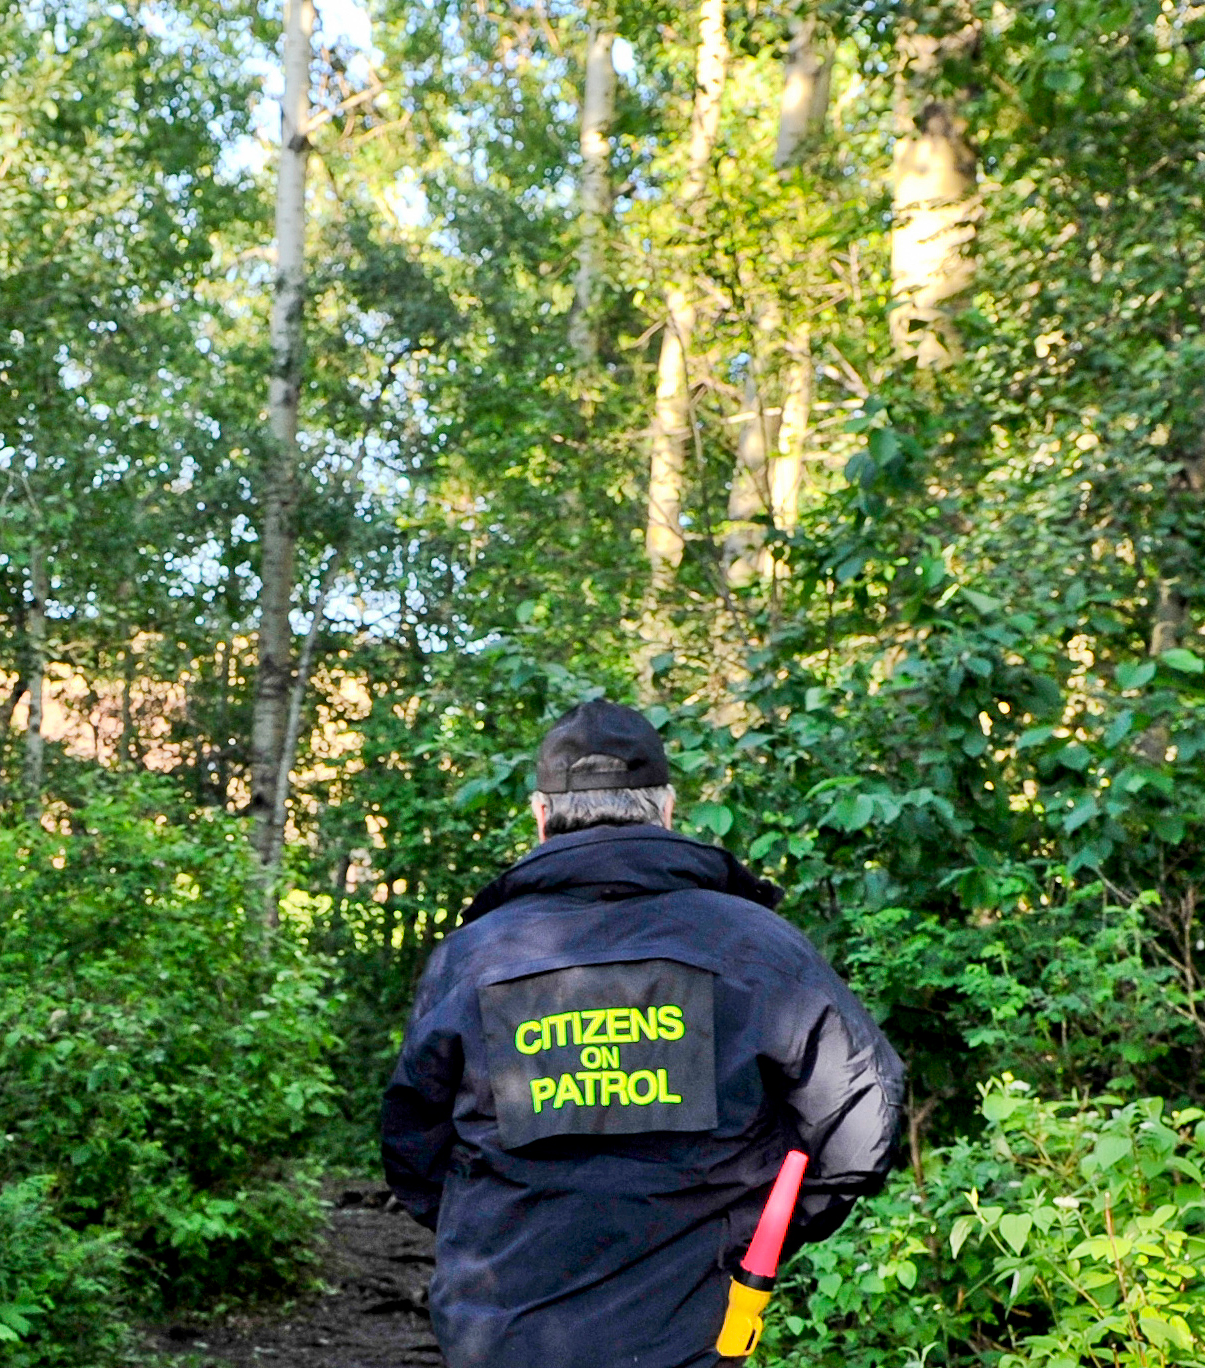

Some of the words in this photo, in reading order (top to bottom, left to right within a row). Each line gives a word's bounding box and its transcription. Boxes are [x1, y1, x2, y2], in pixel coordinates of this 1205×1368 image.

[515, 1004, 685, 1056] CITIZENS
[580, 1045, 620, 1070] ON
[529, 1068, 682, 1113] PATROL
